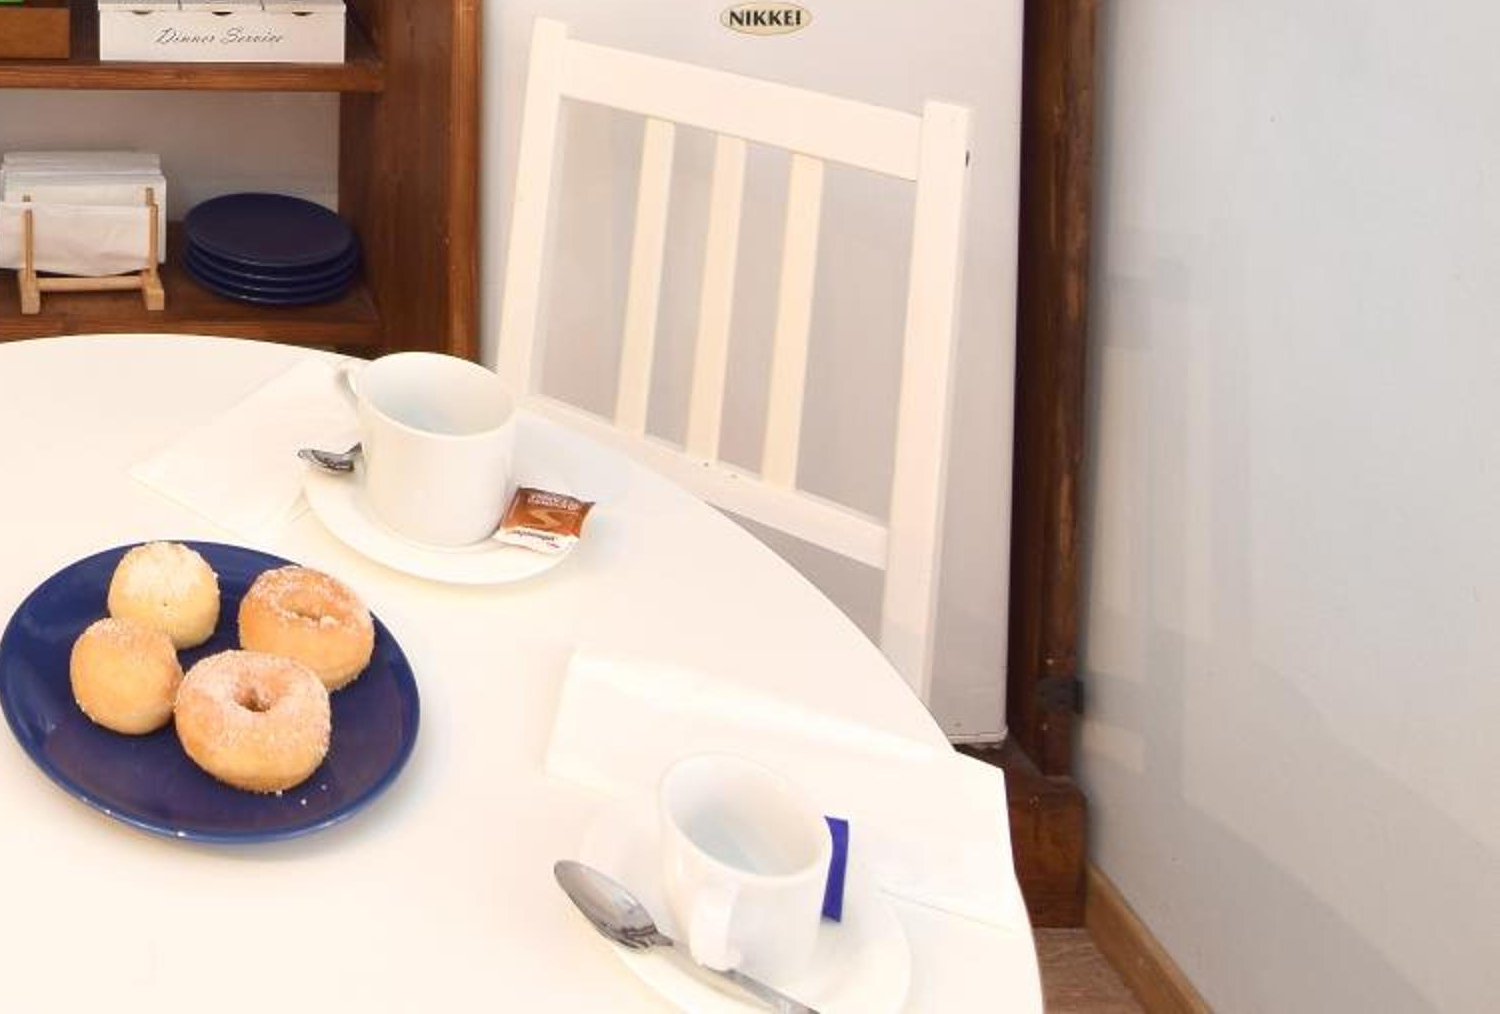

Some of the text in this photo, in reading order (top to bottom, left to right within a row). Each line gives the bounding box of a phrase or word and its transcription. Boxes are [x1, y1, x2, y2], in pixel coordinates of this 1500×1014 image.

[729, 9, 802, 27] NIKKEI
[155, 27, 284, 44] Dinner Service
